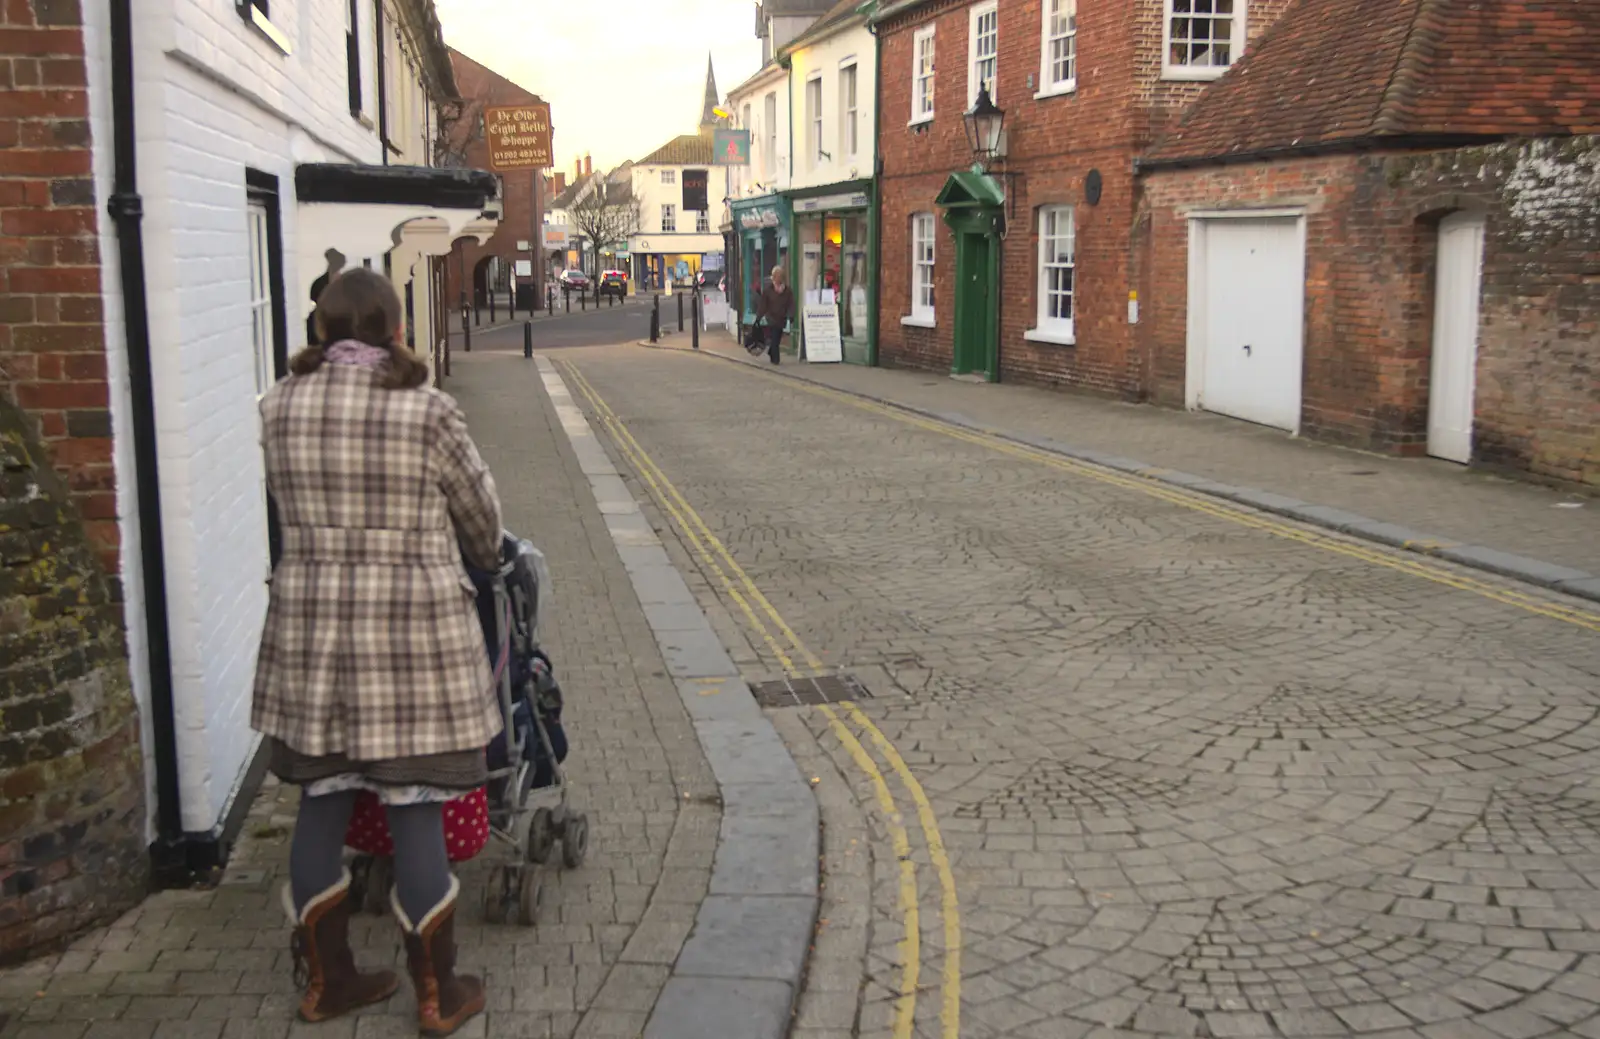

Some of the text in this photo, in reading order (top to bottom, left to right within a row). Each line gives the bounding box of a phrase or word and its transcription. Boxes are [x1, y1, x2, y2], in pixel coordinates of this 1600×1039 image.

[497, 110, 538, 122] Ye Olde
[490, 121, 546, 135] Eight Bells
[502, 135, 537, 146] Shoppe
[494, 151, 517, 159] 01202
